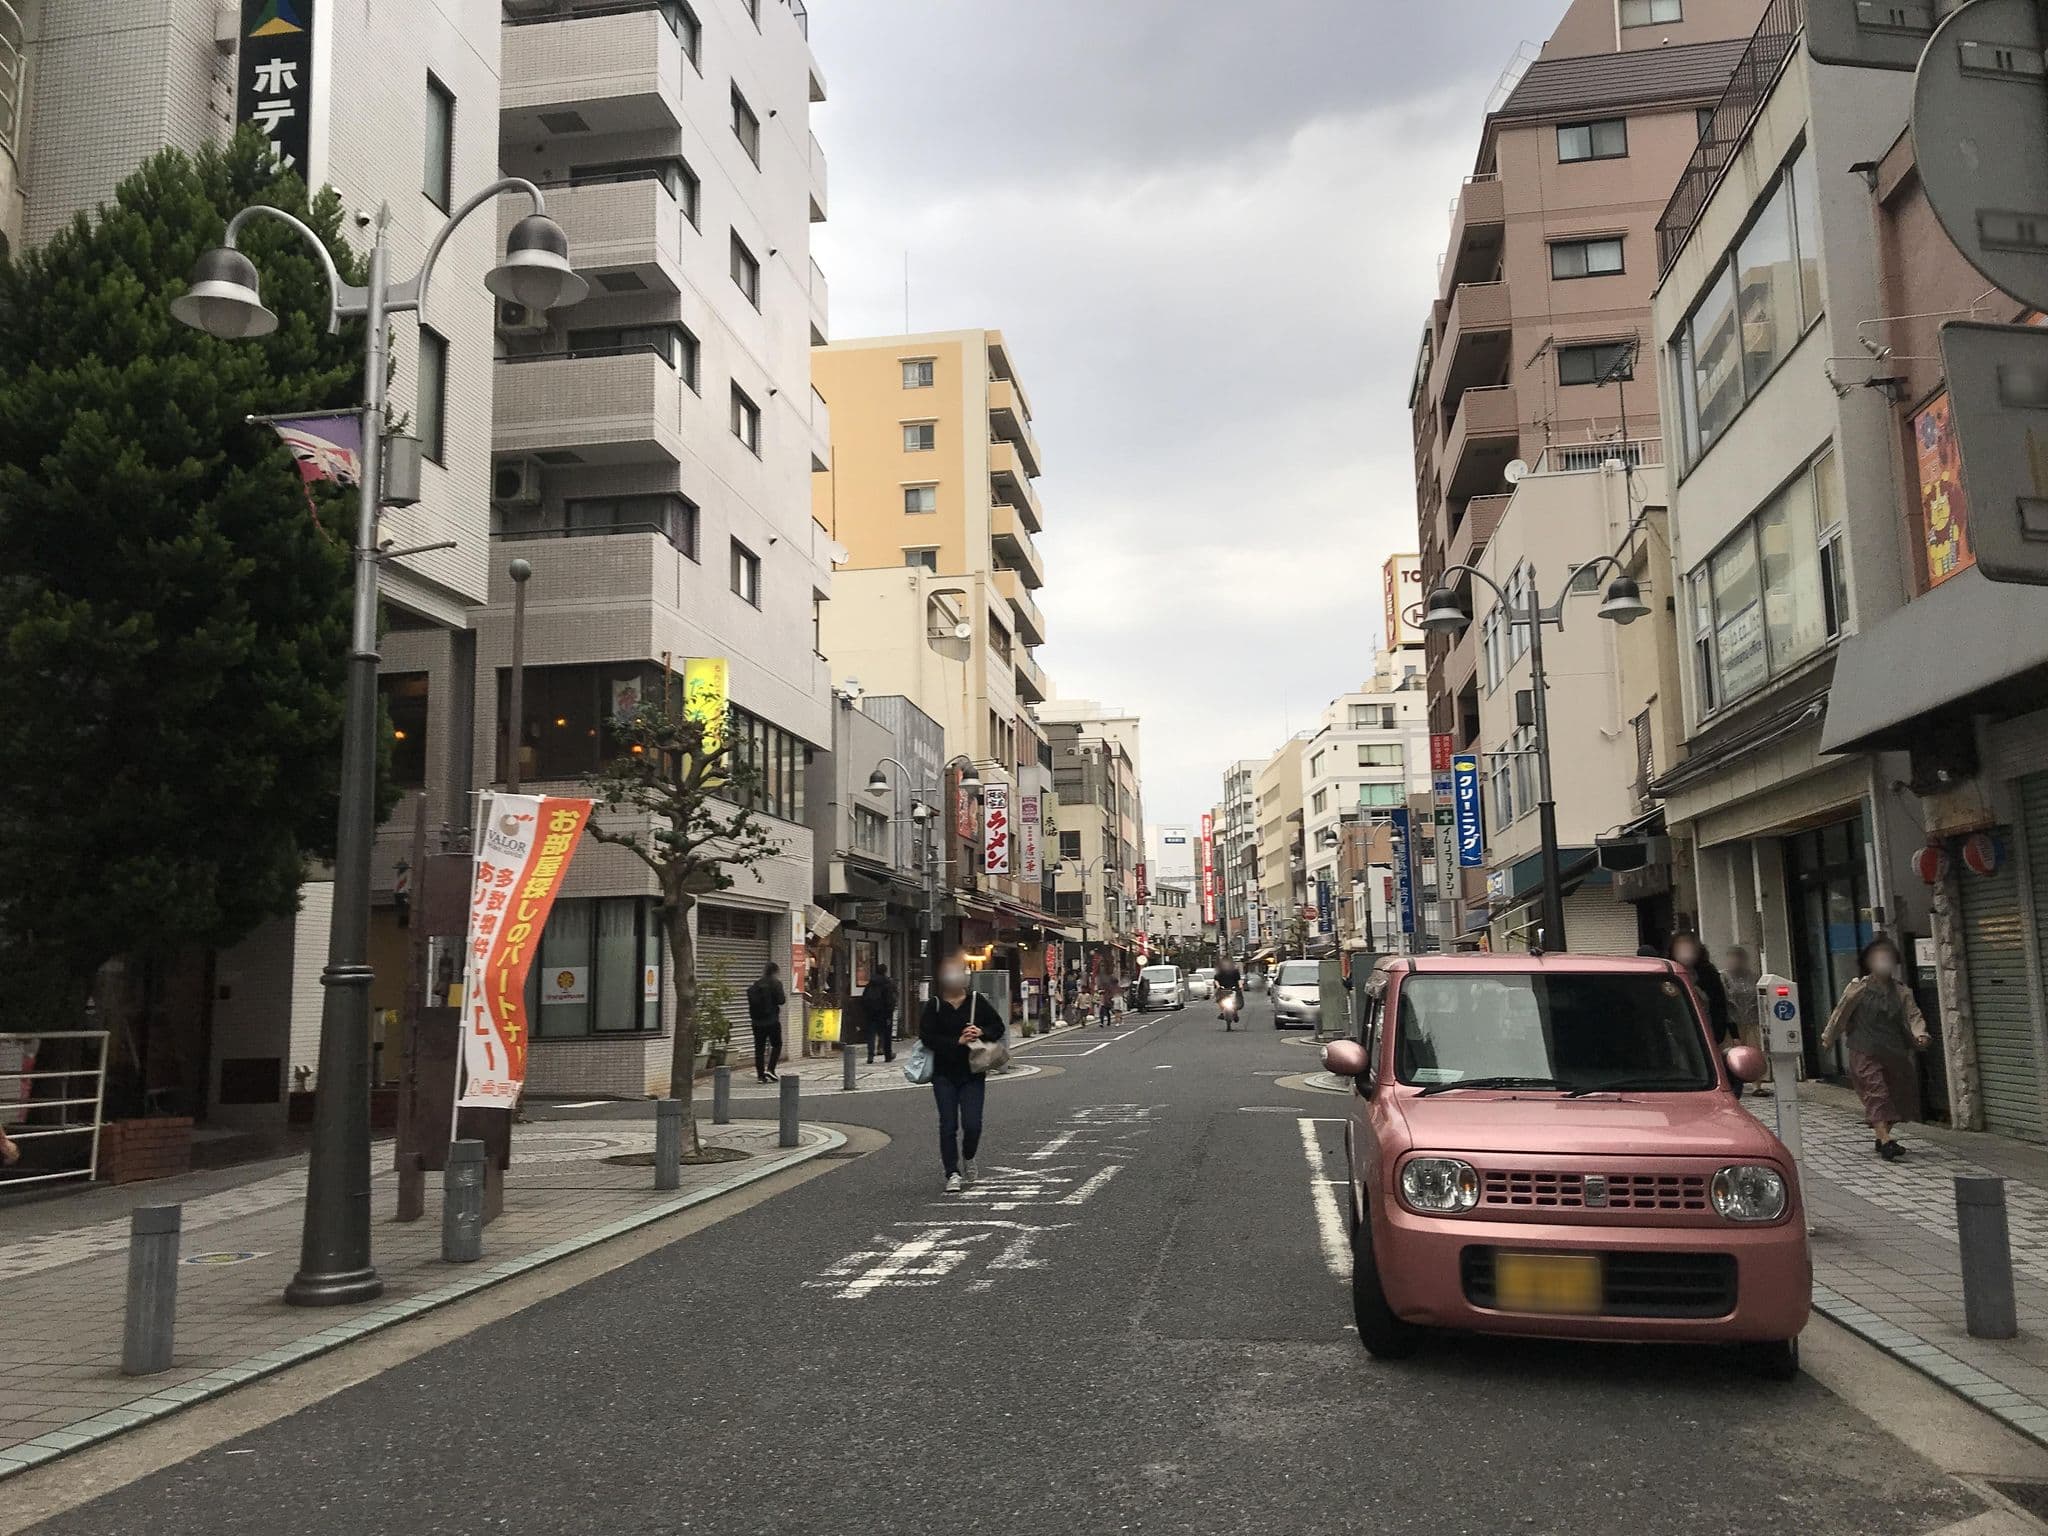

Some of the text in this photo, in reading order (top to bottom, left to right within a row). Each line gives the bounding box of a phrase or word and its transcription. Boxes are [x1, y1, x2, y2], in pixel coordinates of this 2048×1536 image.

[487, 828, 527, 854] VALOR
[986, 810, 1007, 869] ラーメン
[1459, 775, 1480, 850] クリーニング
[473, 868, 514, 958] 多数物件
